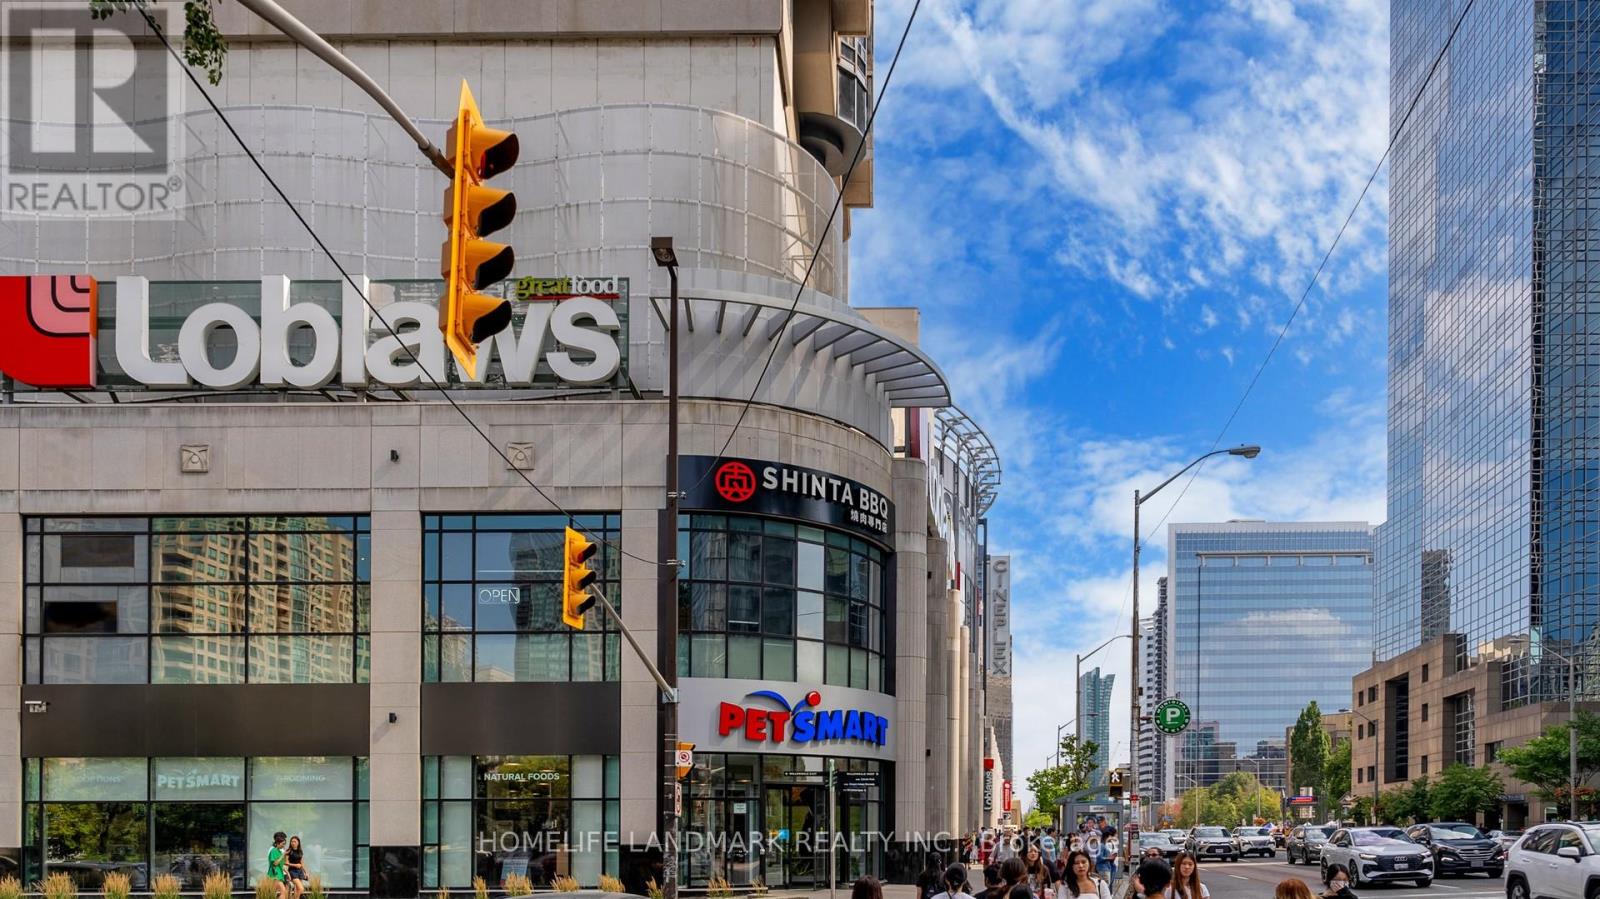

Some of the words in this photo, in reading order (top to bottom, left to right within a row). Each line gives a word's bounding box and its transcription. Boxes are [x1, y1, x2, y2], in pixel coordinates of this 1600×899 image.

[115, 274, 621, 388] Loblaws
[762, 466, 854, 506] SHINTA
[859, 489, 888, 520] BBQ
[480, 589, 519, 603] OPEN
[993, 560, 1007, 675] CINEPLEX
[719, 701, 888, 746] PETSMART
[1166, 707, 1181, 722] P
[157, 774, 240, 789] PETSMART
[483, 772, 526, 781] NATURAL
[528, 772, 560, 781] FOODS
